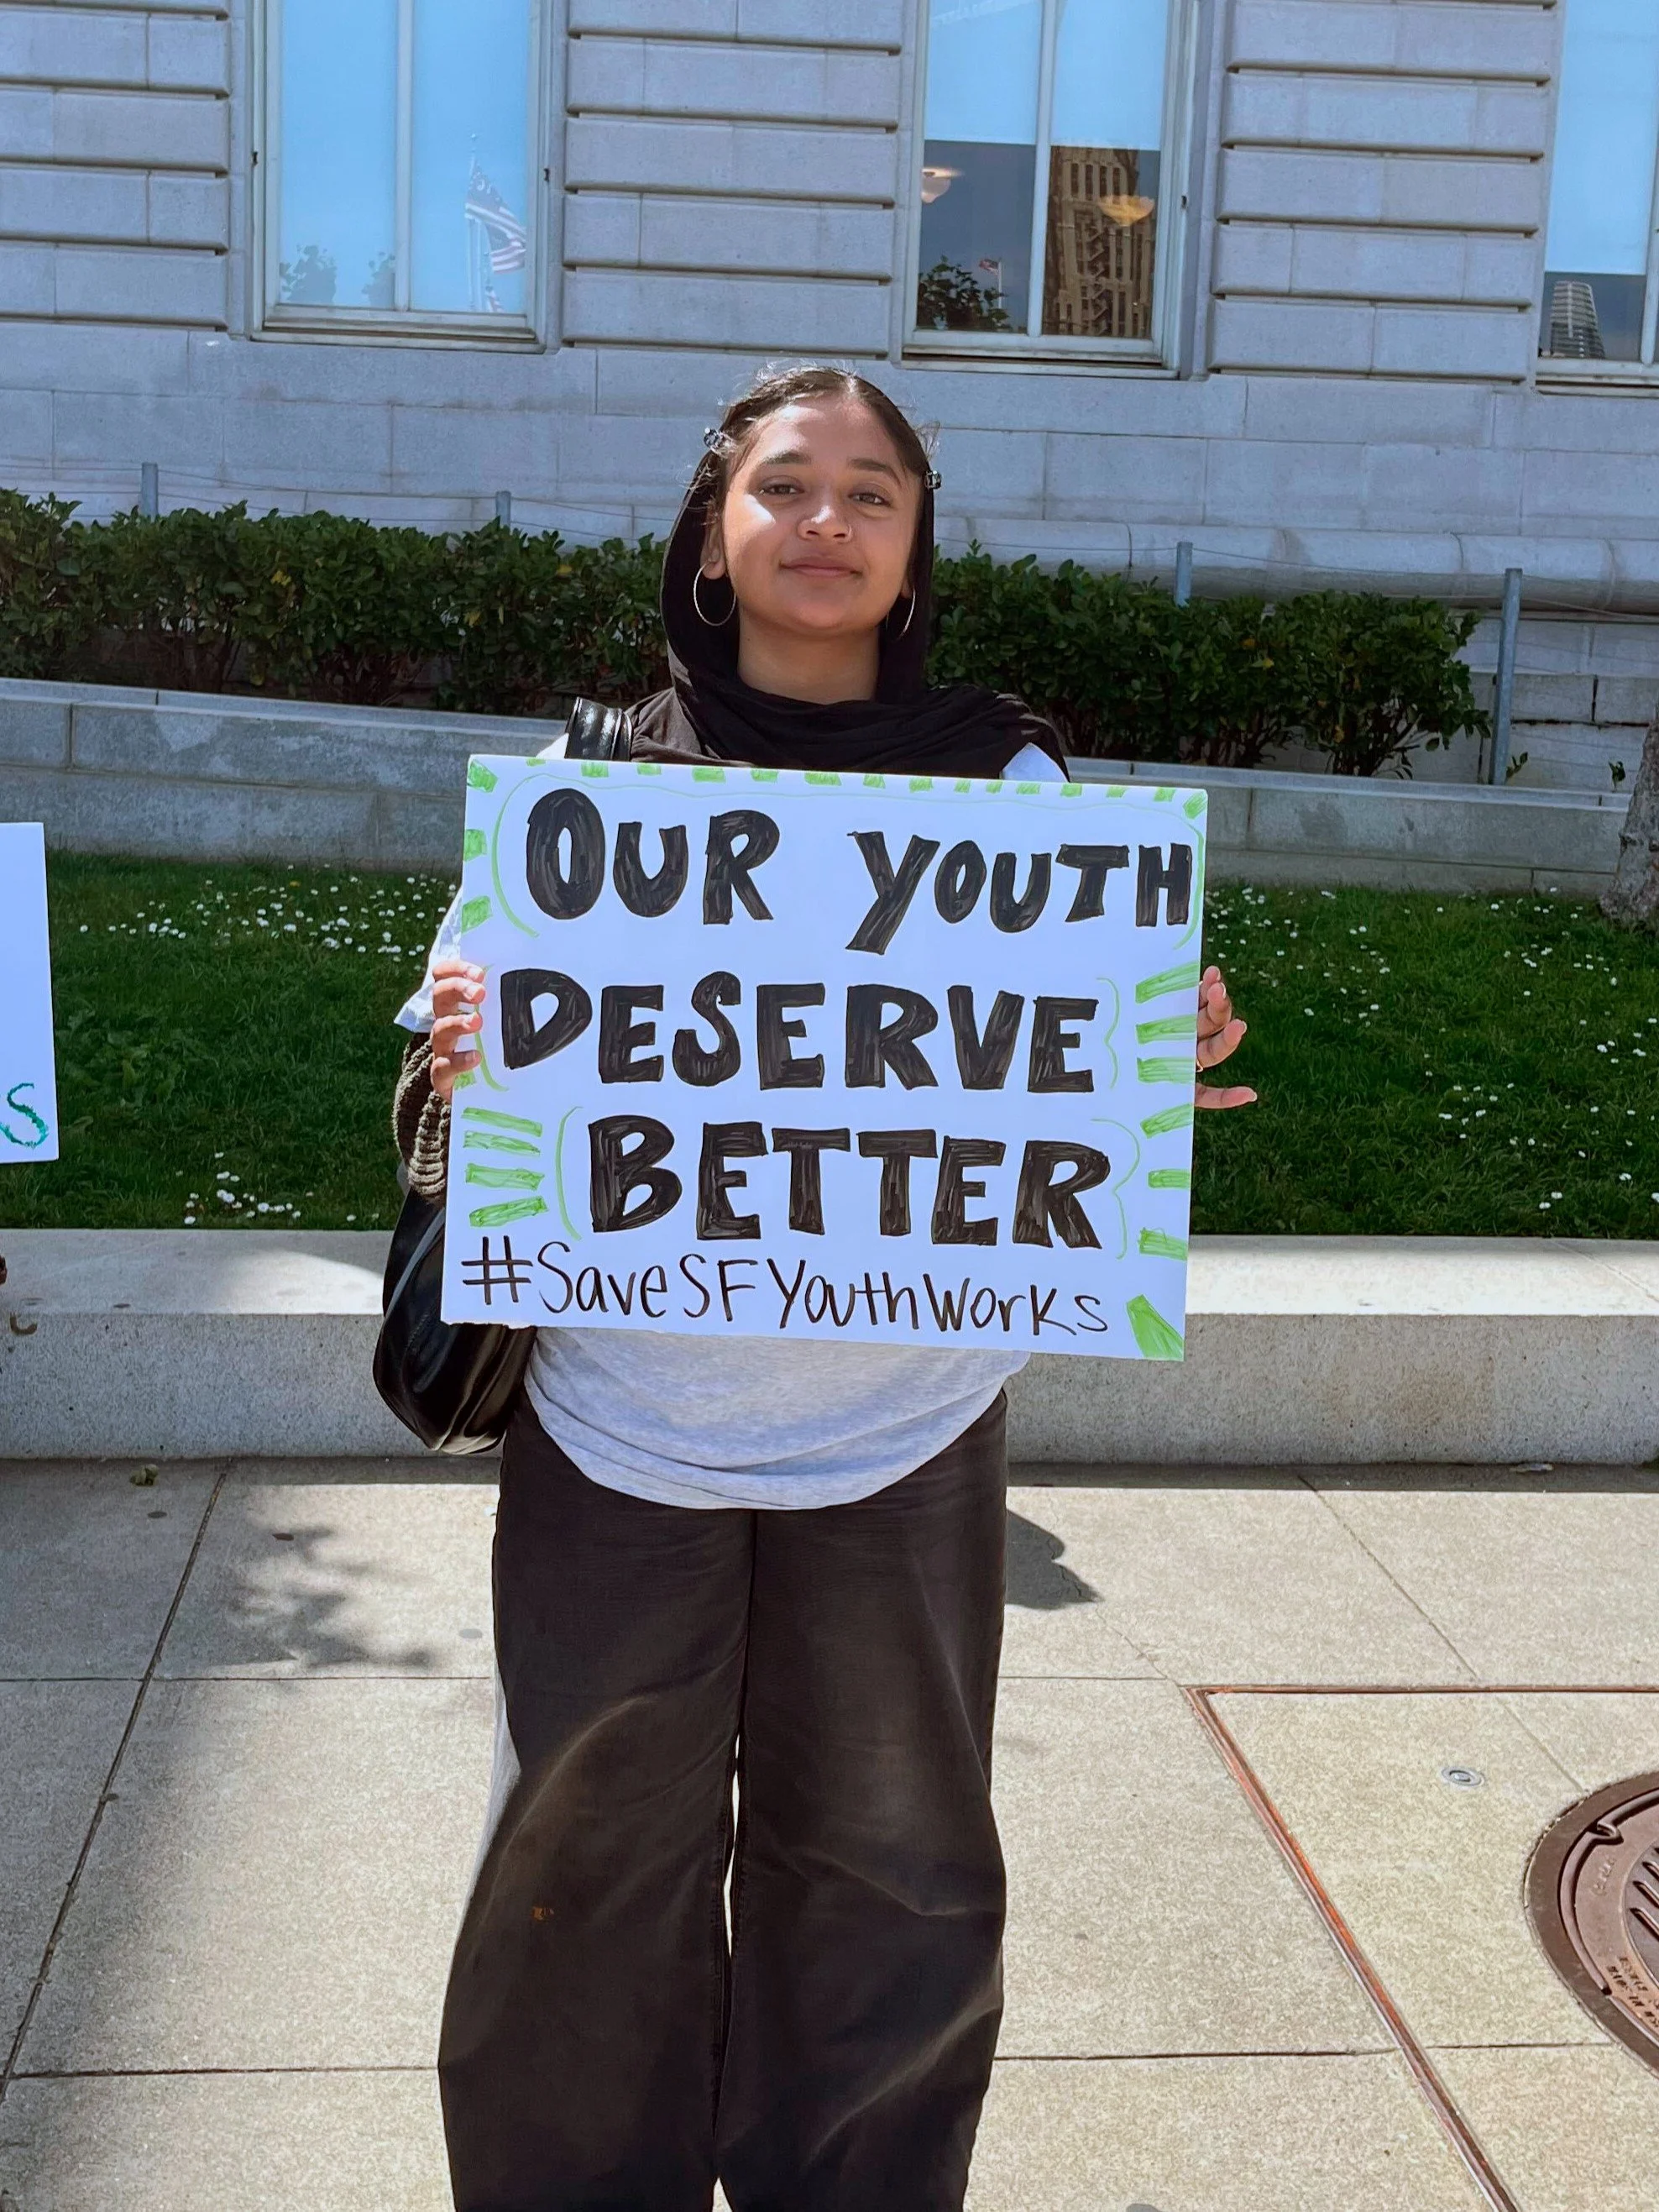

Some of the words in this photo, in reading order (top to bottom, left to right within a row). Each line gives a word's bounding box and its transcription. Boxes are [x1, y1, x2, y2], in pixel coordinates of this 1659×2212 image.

[526, 789, 779, 925] OUR
[845, 831, 1192, 955] YOUTH
[500, 969, 1099, 1093] DESERVE
[589, 1115, 1110, 1249] BETTER
